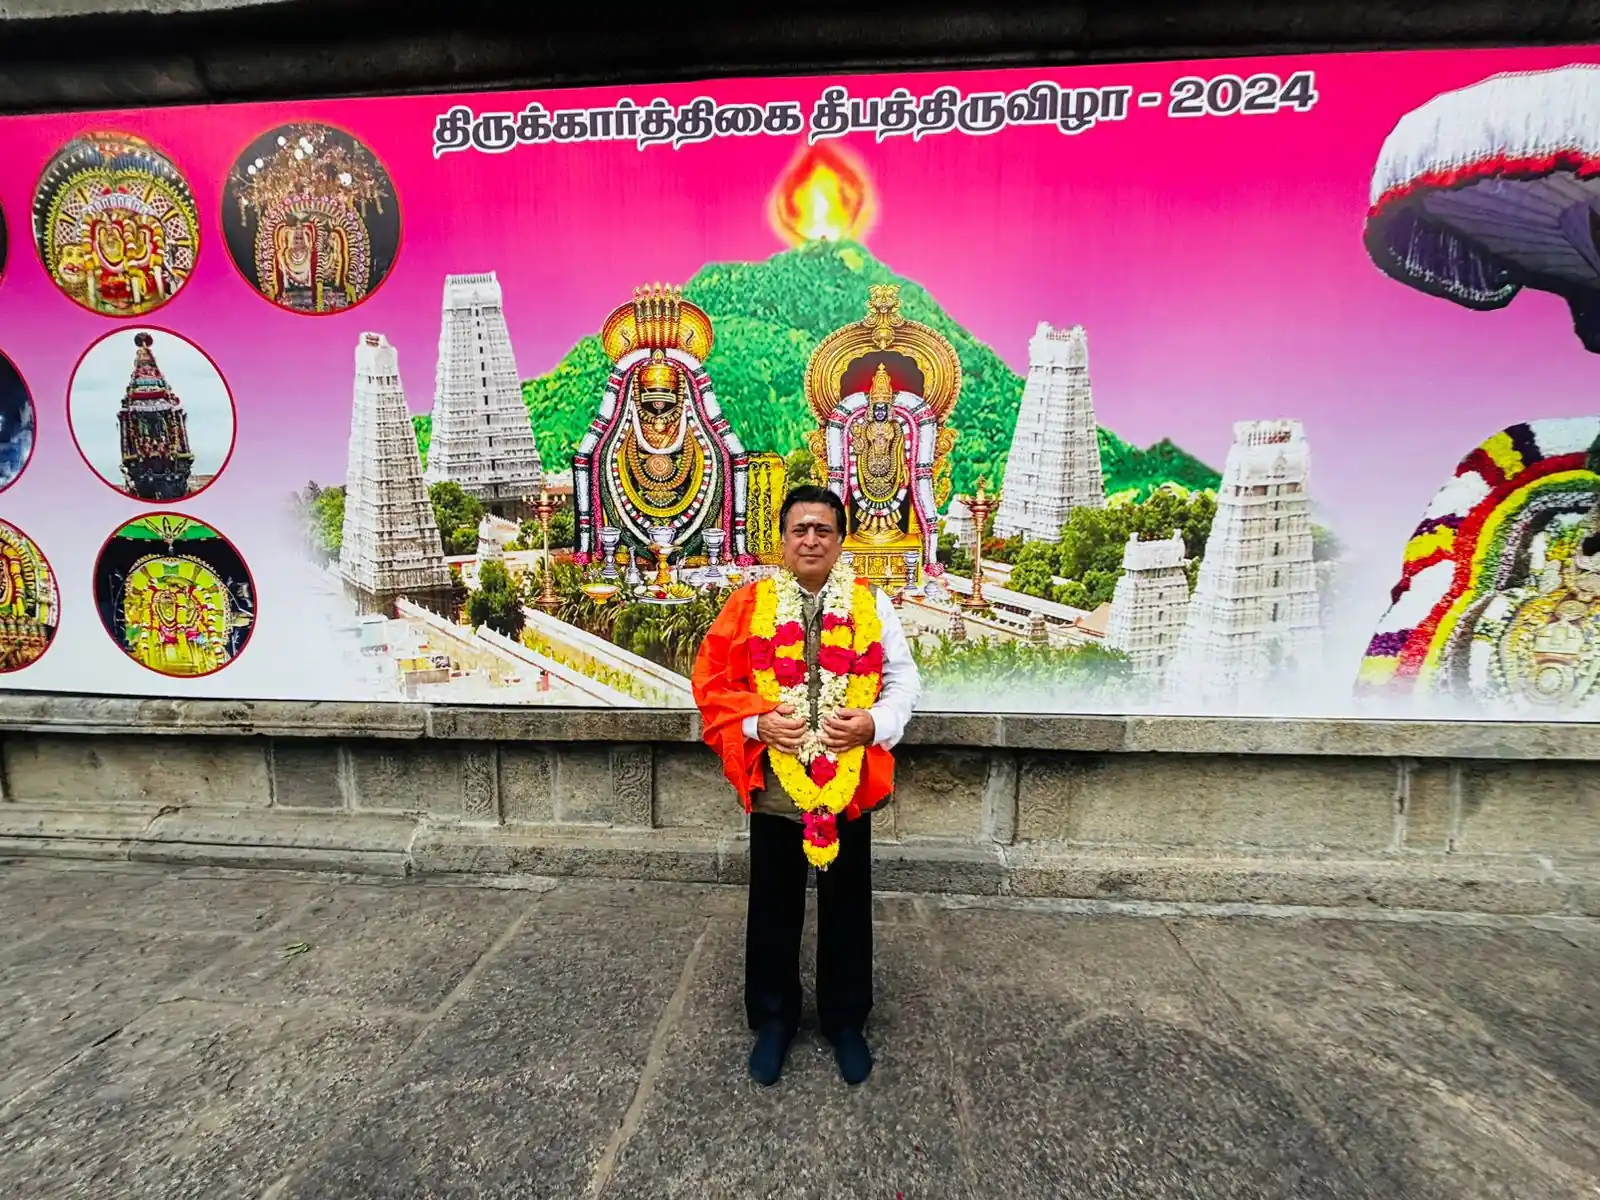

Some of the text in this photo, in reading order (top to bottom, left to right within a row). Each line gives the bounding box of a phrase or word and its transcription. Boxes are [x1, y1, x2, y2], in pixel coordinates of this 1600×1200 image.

[434, 98, 803, 157] திருக்கார்த்திகை
[809, 83, 1131, 144] தீபத்திருவிழா
[1169, 72, 1317, 117] 2024
